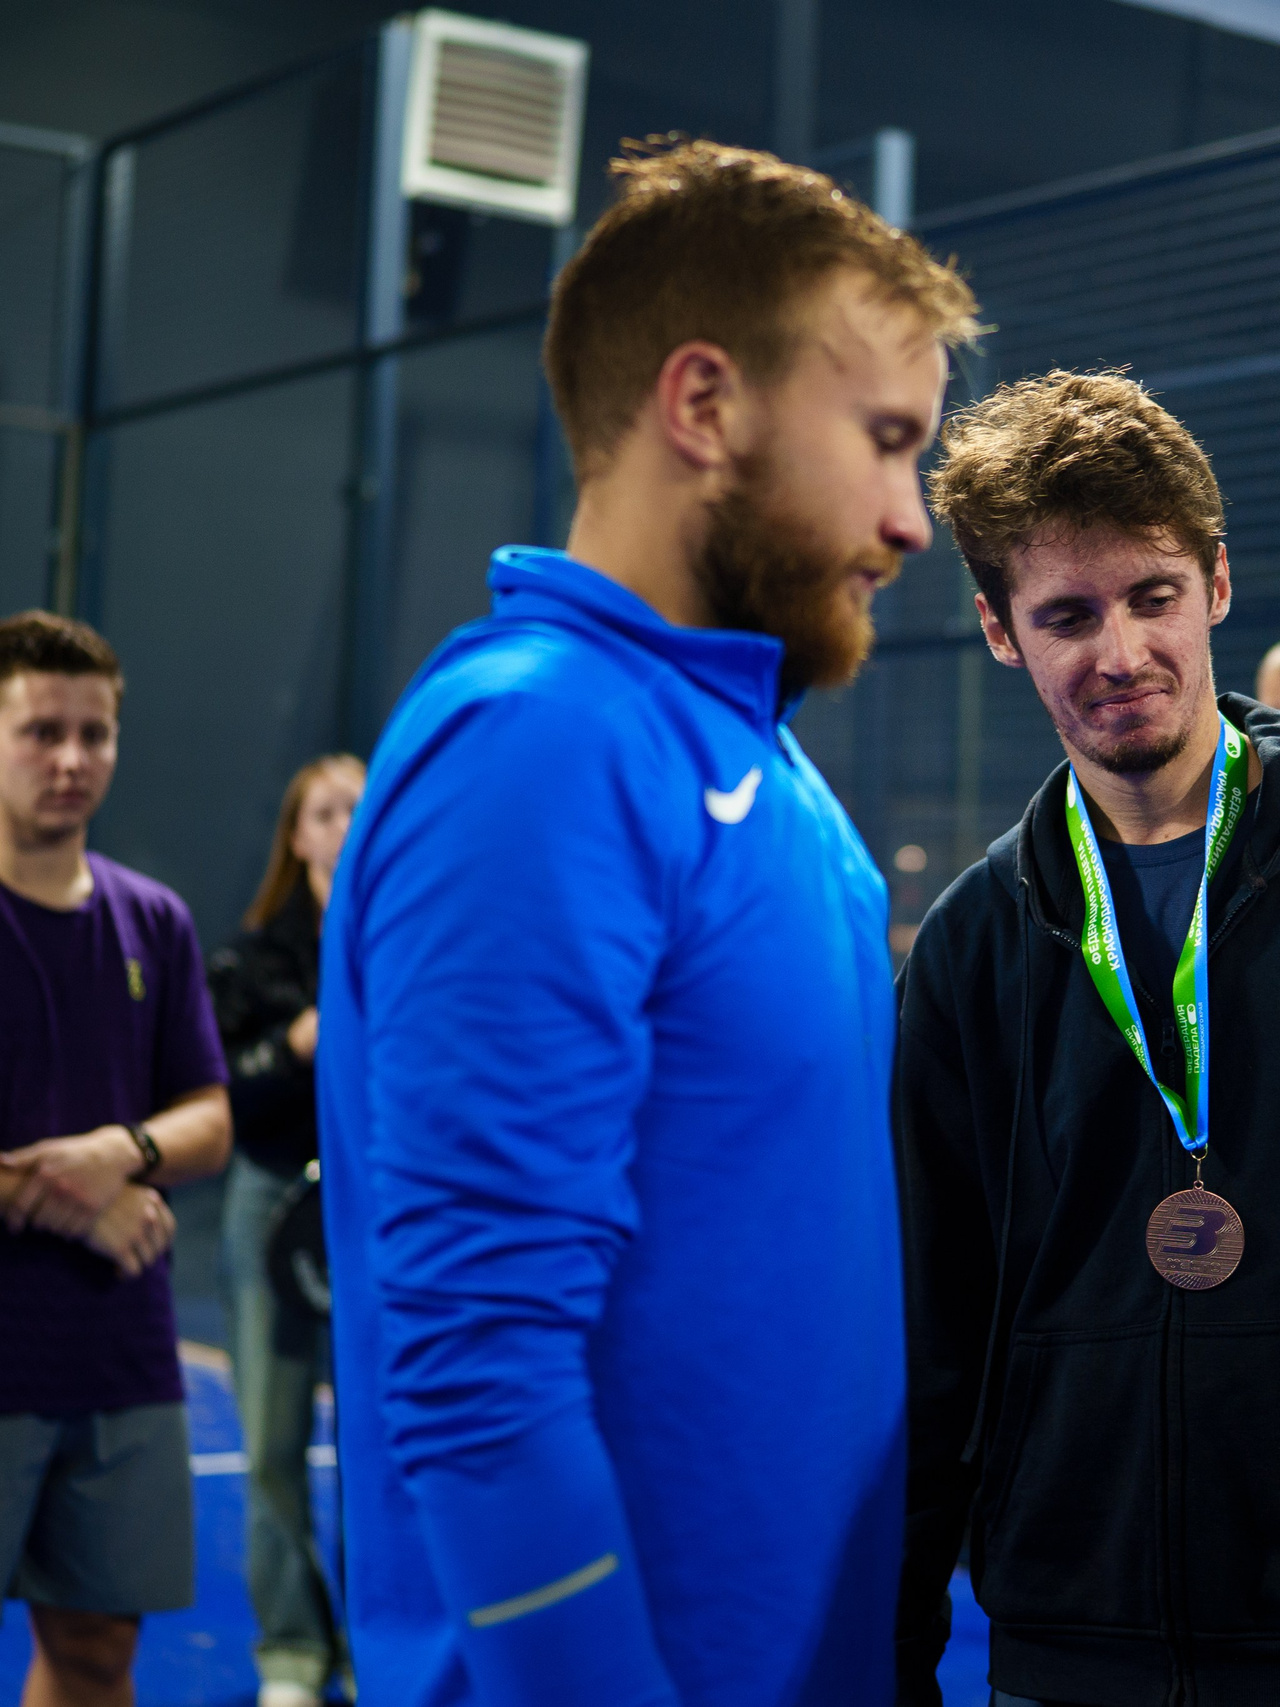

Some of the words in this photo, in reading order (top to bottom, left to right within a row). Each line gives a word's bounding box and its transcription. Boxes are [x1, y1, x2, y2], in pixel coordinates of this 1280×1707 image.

[1080, 819, 1096, 854] КРАЯ
[1210, 787, 1242, 867] ФЕДЕРАЦИЯ
[1077, 841, 1095, 893] ПАДЕЛА
[1087, 892, 1102, 965] ФЕДЕРАЦИЯ
[1090, 853, 1121, 971] КРАСНОДАРСКОГО
[1176, 1004, 1193, 1074] ФЕДЕРАЦИЯ
[1190, 1027, 1200, 1074] ПАДЕЛА
[1158, 1205, 1228, 1257] 3
